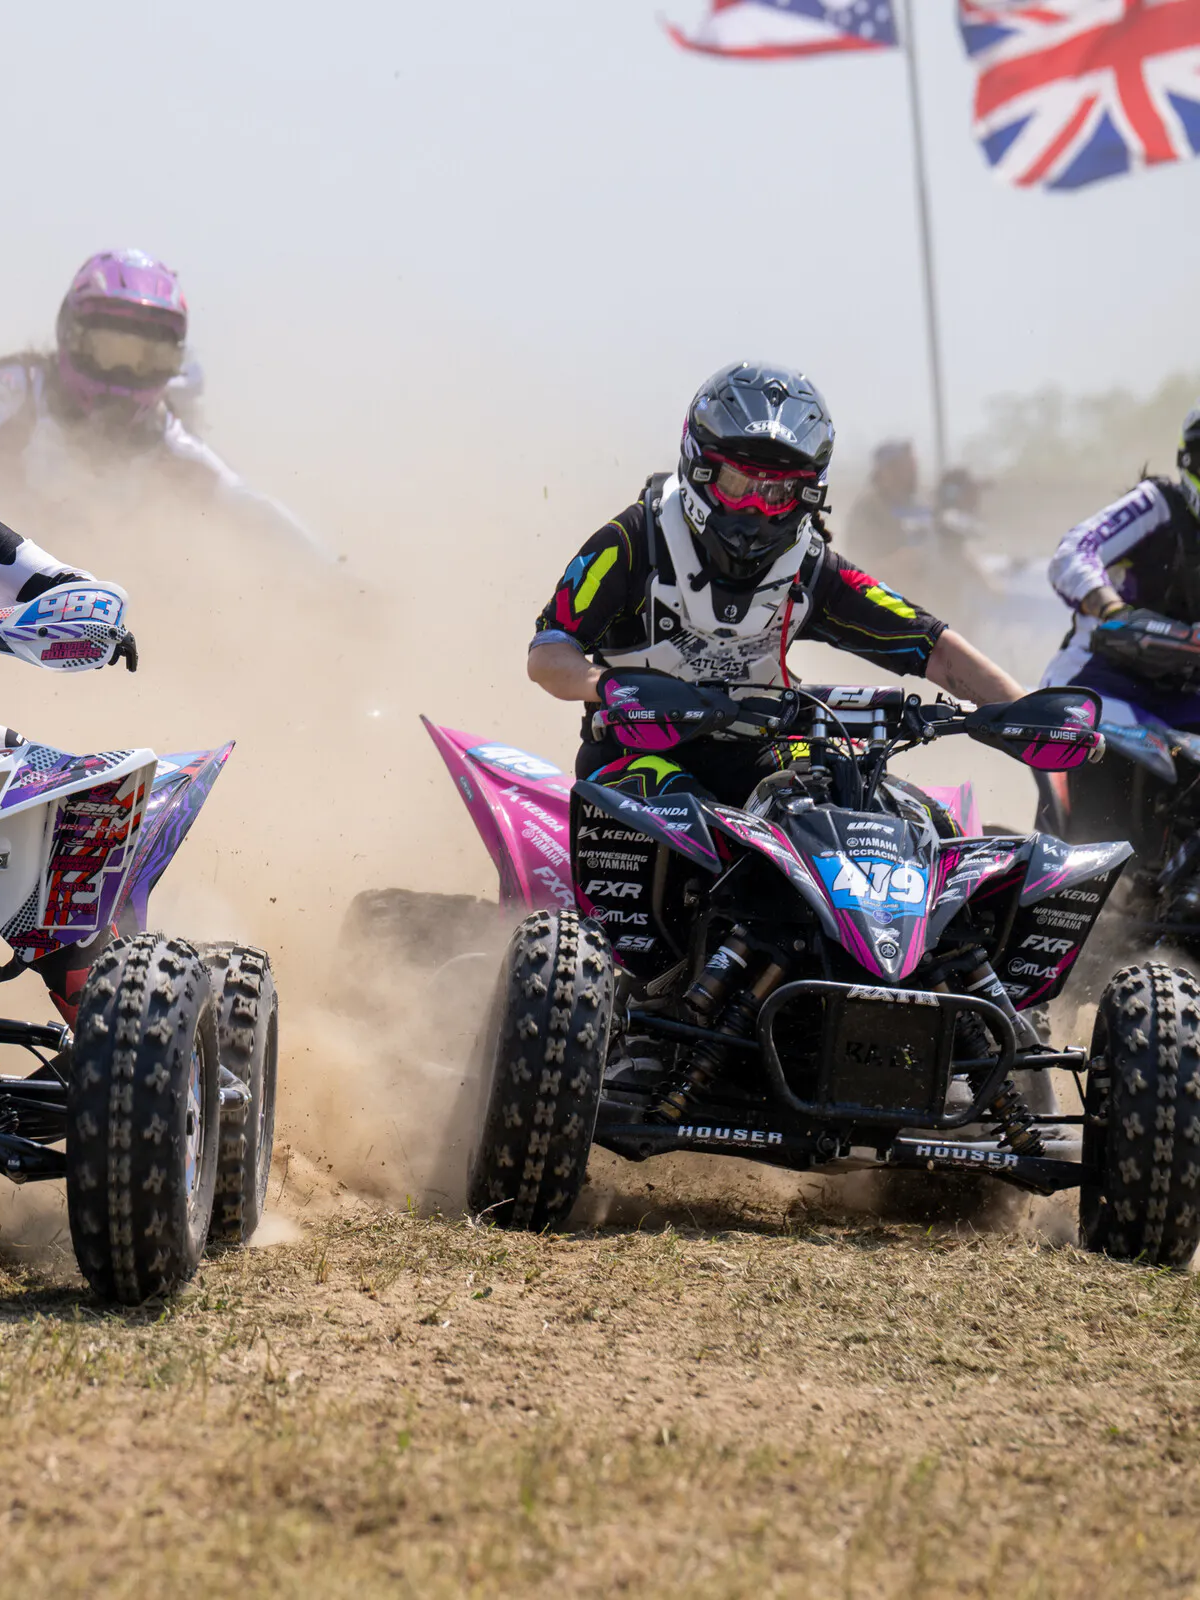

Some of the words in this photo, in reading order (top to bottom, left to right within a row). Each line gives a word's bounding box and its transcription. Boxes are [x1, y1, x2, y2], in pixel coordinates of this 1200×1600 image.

[751, 421, 792, 438] SHOEI
[35, 590, 122, 624] 983
[689, 658, 742, 672] ATLAS
[628, 710, 656, 720] WISE
[684, 711, 705, 719] SSI
[1002, 727, 1023, 735] SSI
[1050, 730, 1077, 740] WISE
[519, 800, 565, 833] KENDA
[641, 805, 688, 816] KENDA
[664, 822, 692, 831] SSI
[602, 829, 655, 844] KENDA
[529, 835, 564, 868] YAMAHA
[859, 837, 898, 853] YAMAHA
[578, 850, 648, 863] WAYNESBURG
[600, 859, 640, 872] YAMAHA
[532, 865, 576, 907] FXR
[584, 879, 643, 899] FXR
[832, 861, 925, 904] 419
[601, 910, 648, 925] ATLAS
[1032, 906, 1092, 922] WAYNESBURG
[1047, 915, 1082, 930] YAMAHA
[617, 935, 656, 948] SSI
[1020, 934, 1075, 955] FXR
[1018, 962, 1059, 979] ATLAS
[677, 1125, 783, 1144] HOUSER
[915, 1145, 1019, 1167] HOUSER
